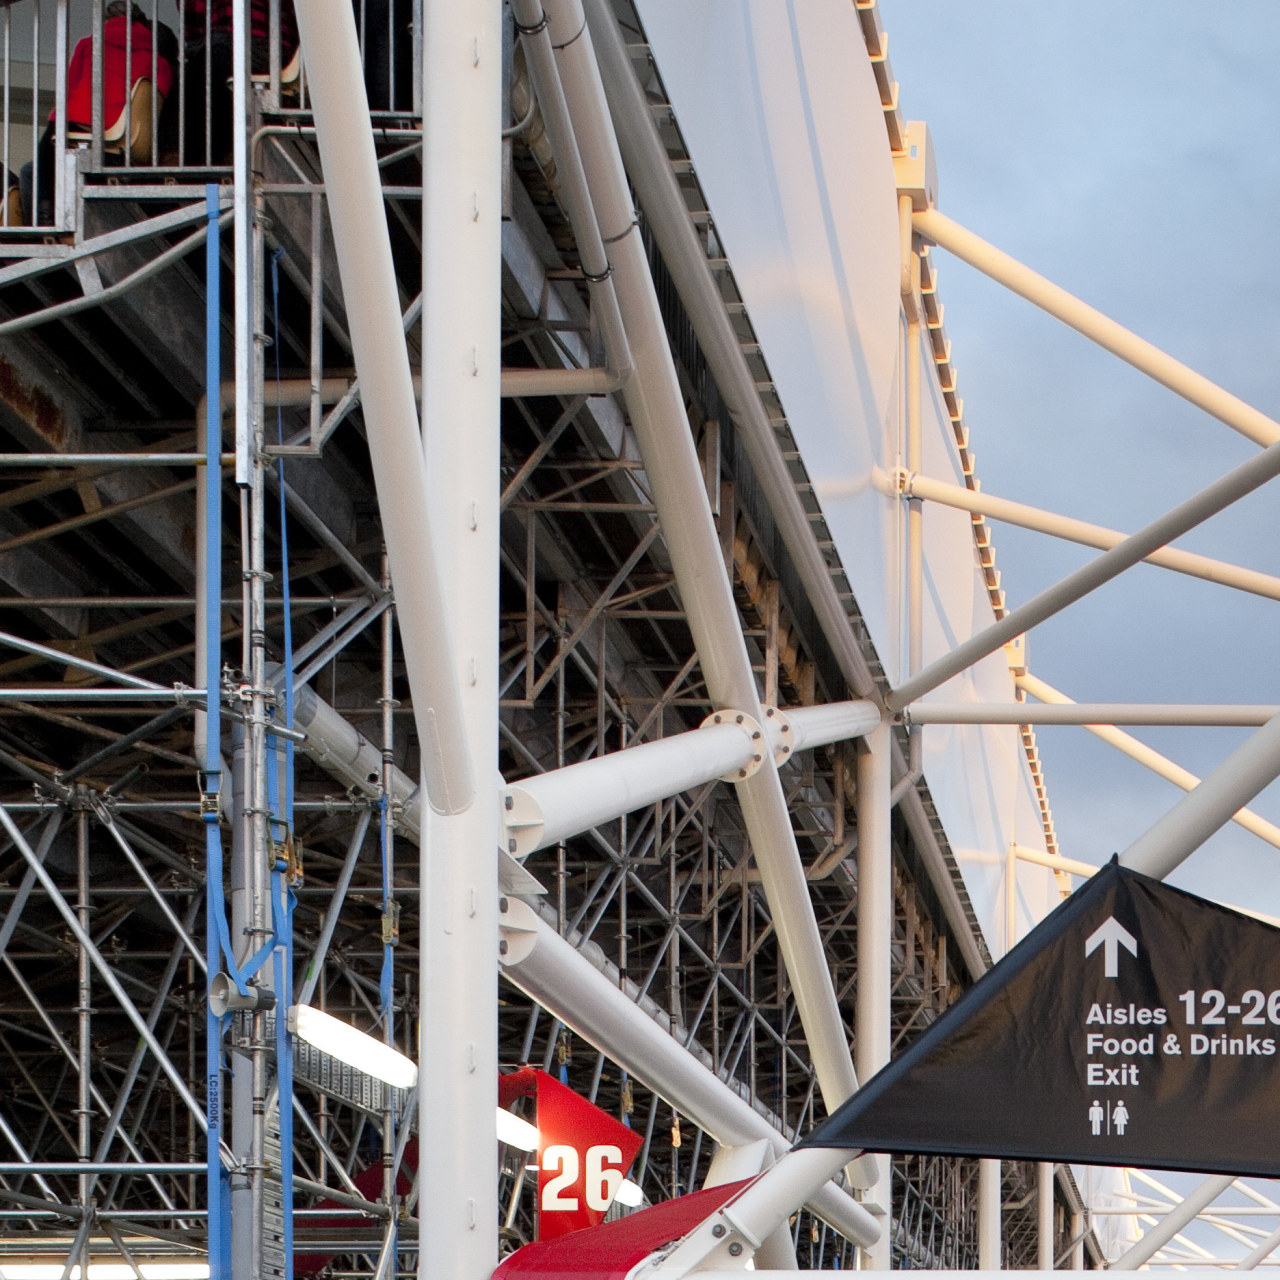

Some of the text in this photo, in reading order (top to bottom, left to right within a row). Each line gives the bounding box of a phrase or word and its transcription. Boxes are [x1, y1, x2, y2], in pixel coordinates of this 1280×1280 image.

[1086, 1004, 1167, 1025] Aisles
[1087, 1034, 1276, 1055] Food & Drinks
[1087, 1064, 1140, 1085] Exit
[542, 1145, 624, 1211] 26
